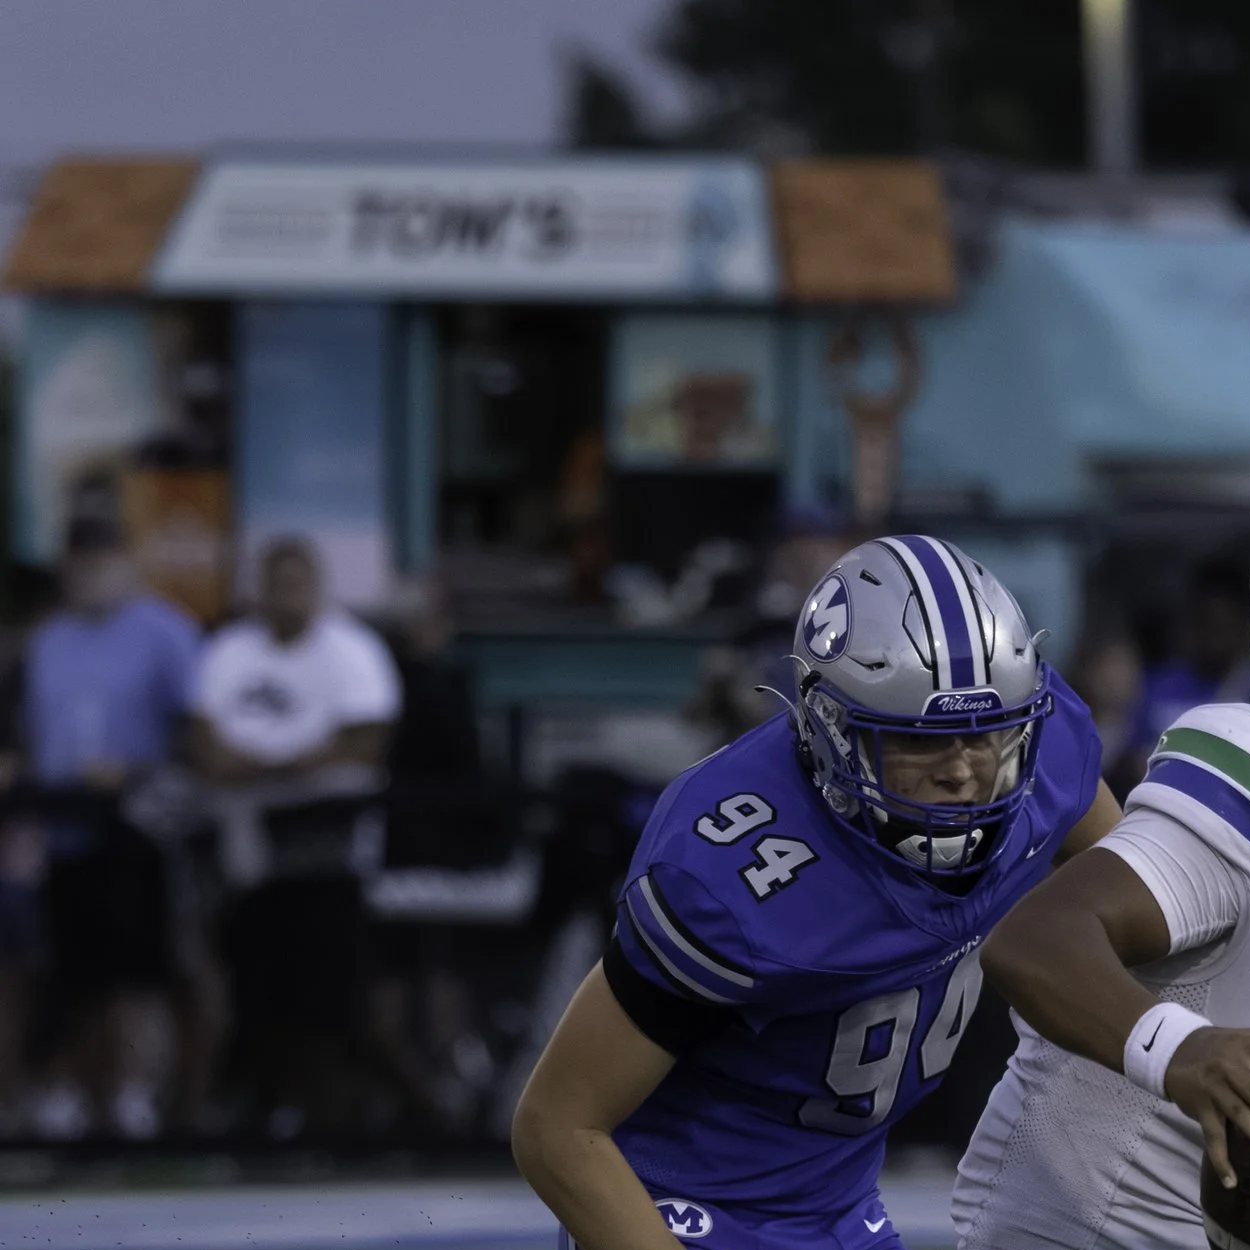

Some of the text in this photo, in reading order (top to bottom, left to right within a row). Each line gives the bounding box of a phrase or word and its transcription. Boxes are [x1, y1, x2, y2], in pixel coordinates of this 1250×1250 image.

[803, 576, 848, 658] M
[938, 696, 992, 713] Vikings
[692, 792, 820, 903] 94
[797, 948, 984, 1138] 94
[656, 1203, 704, 1234] M
